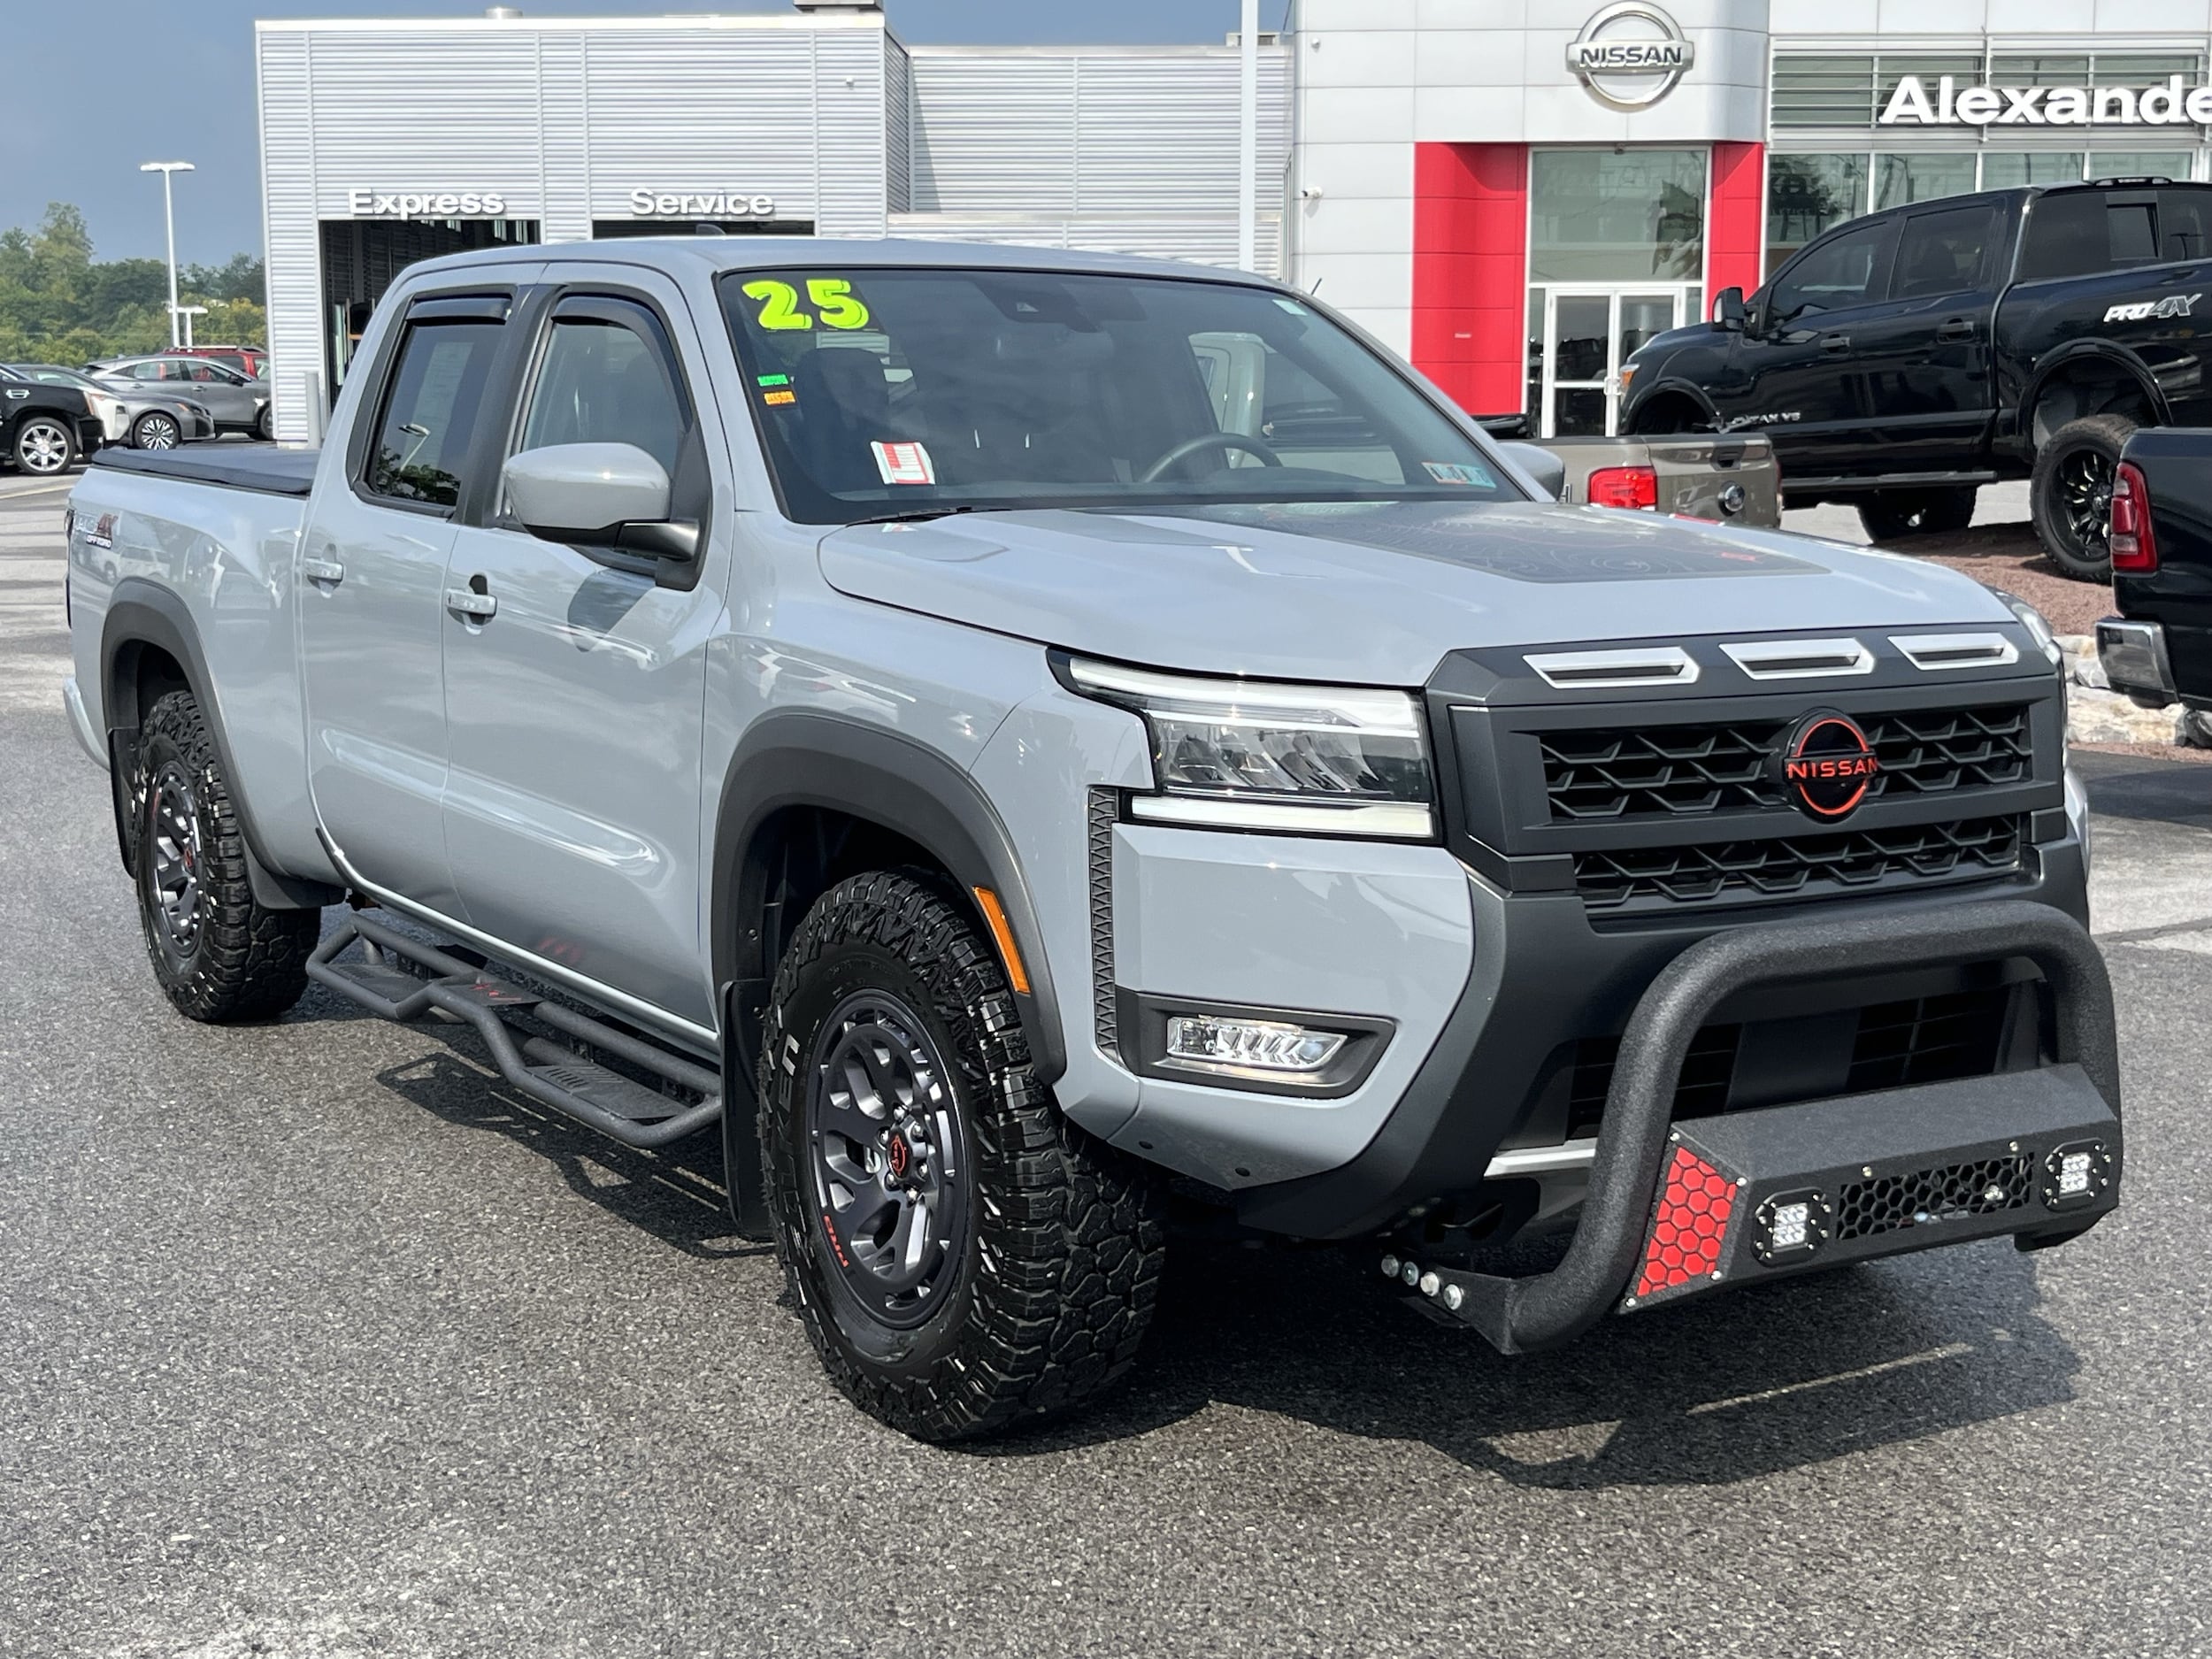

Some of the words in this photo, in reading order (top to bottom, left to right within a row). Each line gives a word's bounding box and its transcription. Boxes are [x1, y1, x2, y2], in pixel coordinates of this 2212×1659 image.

[1580, 46, 1682, 65] NISSAN
[348, 188, 506, 219] Express
[630, 186, 775, 216] Service
[741, 278, 870, 330] 25
[1786, 757, 1878, 780] NISSAN
